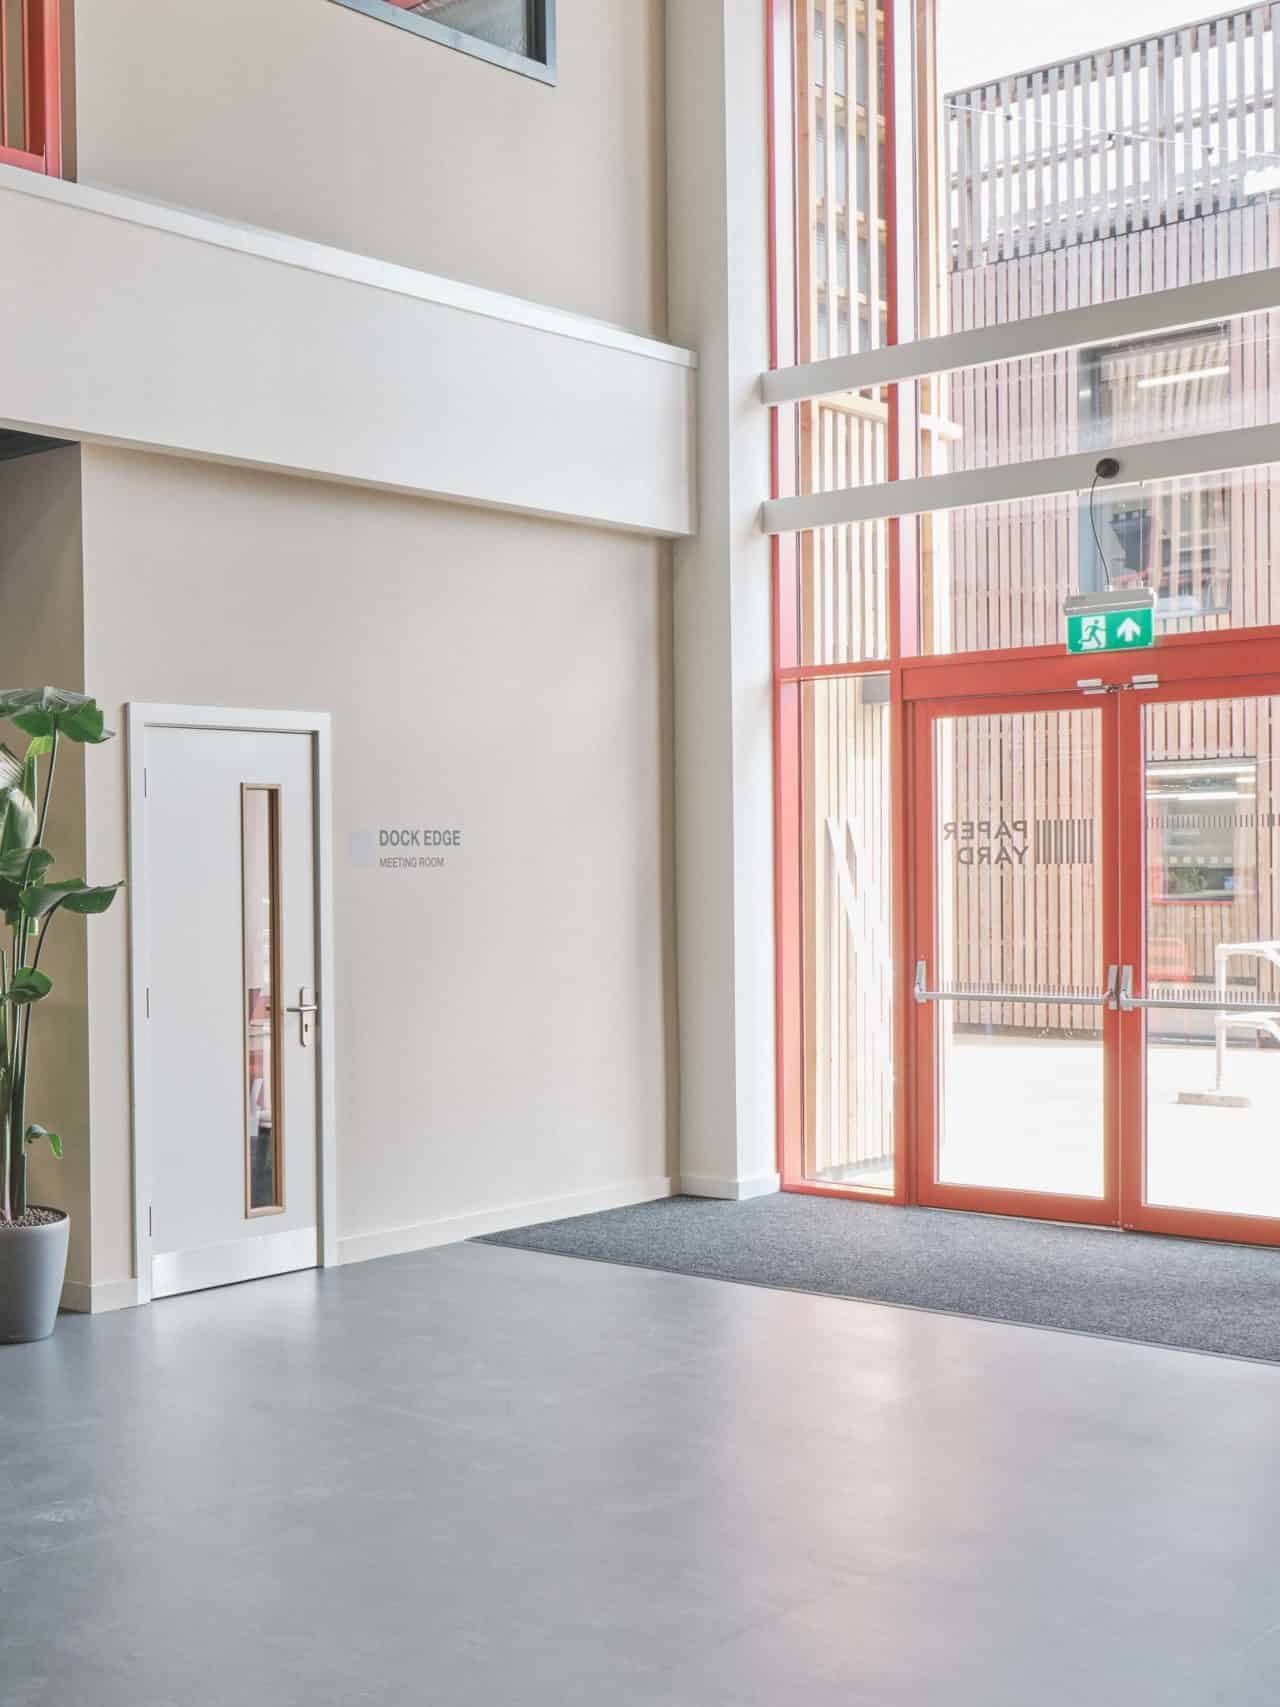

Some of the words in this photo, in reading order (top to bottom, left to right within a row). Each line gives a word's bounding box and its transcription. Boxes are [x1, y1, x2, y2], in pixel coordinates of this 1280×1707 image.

[379, 829, 420, 847] DOCK
[423, 829, 461, 846] EDGE
[379, 857, 417, 868] MEETING
[419, 857, 445, 867] ROOM
